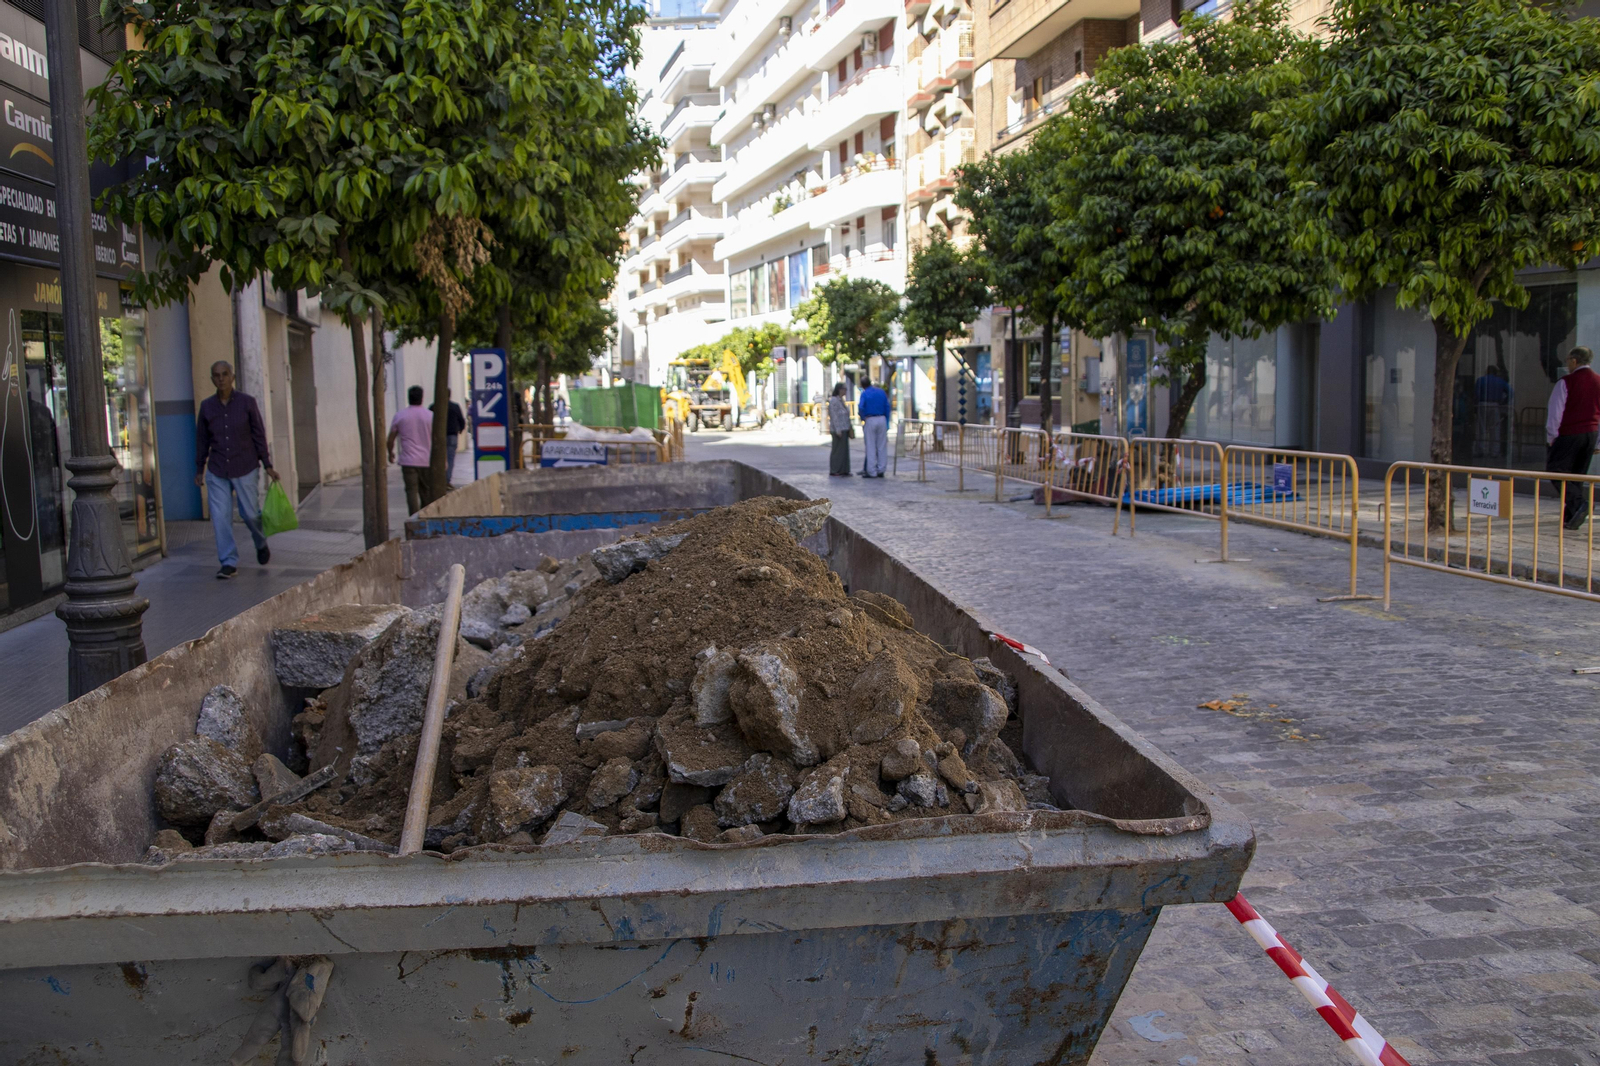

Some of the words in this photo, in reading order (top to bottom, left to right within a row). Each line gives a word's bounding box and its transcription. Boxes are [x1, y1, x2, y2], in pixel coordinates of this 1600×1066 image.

[46, 199, 56, 218] EN
[19, 226, 25, 246] Y
[29, 229, 60, 253] JAMONES
[95, 241, 117, 265] IBÉRICO
[473, 354, 503, 390] P
[1473, 499, 1497, 510] Terracivil
